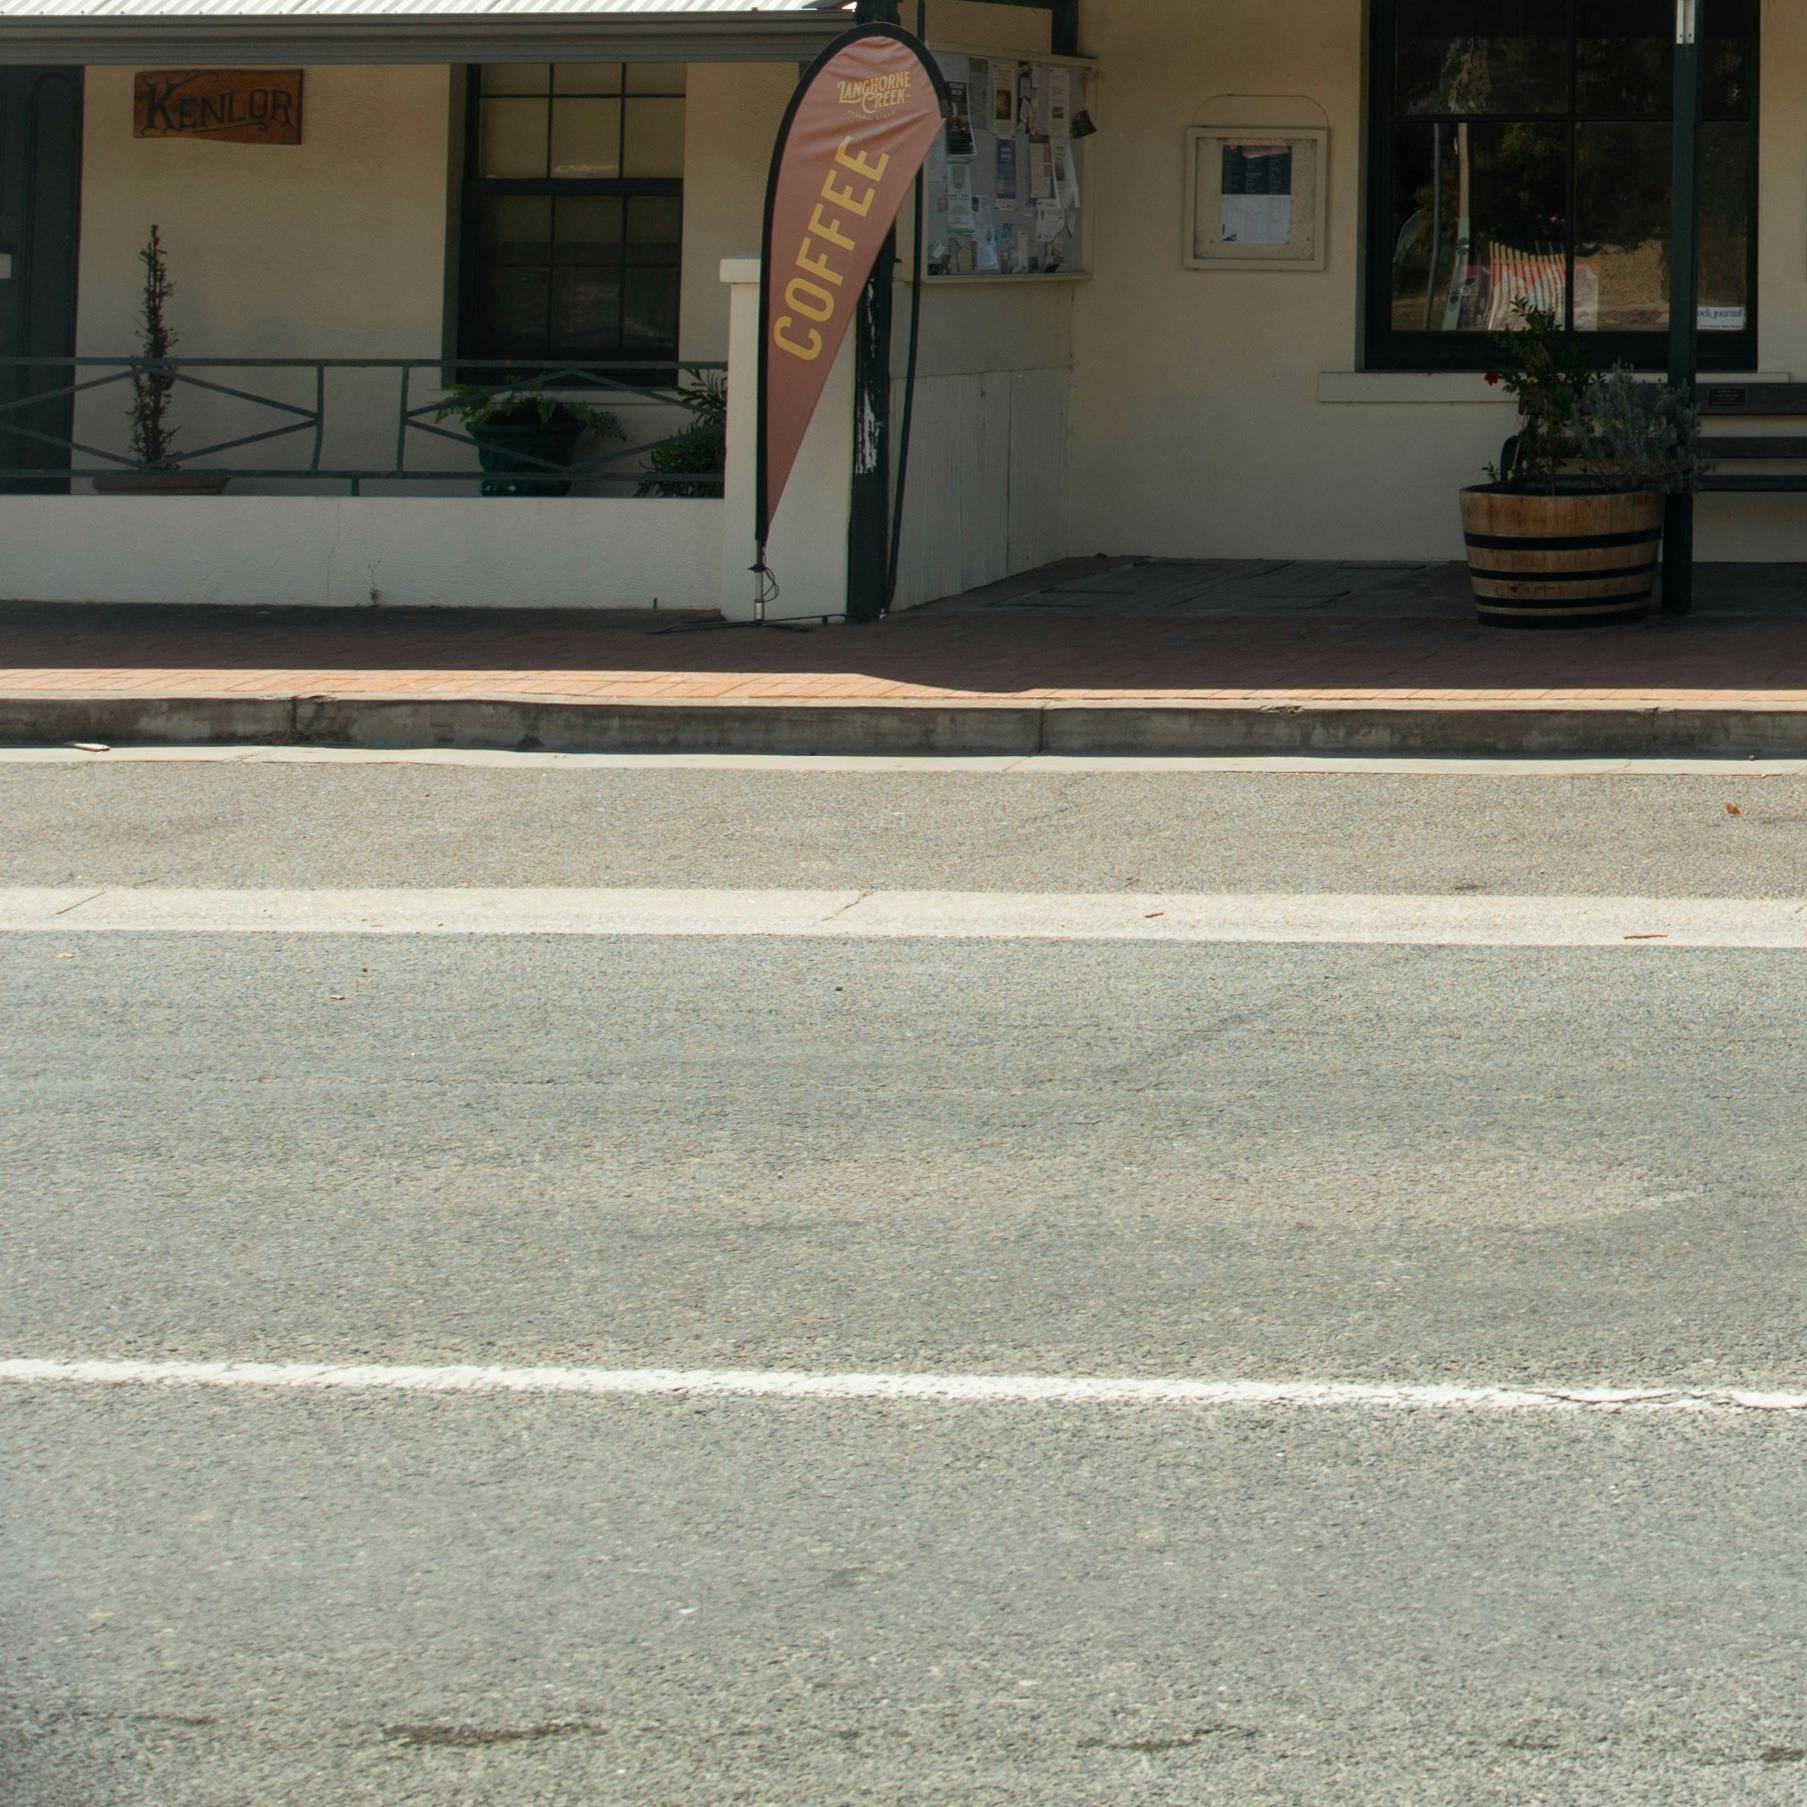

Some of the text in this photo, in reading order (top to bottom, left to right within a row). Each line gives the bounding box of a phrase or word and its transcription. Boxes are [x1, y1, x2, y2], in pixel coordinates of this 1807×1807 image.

[836, 71, 912, 104] LANGHORNE
[861, 88, 906, 114] CREEK
[773, 135, 890, 361] COFFEE
